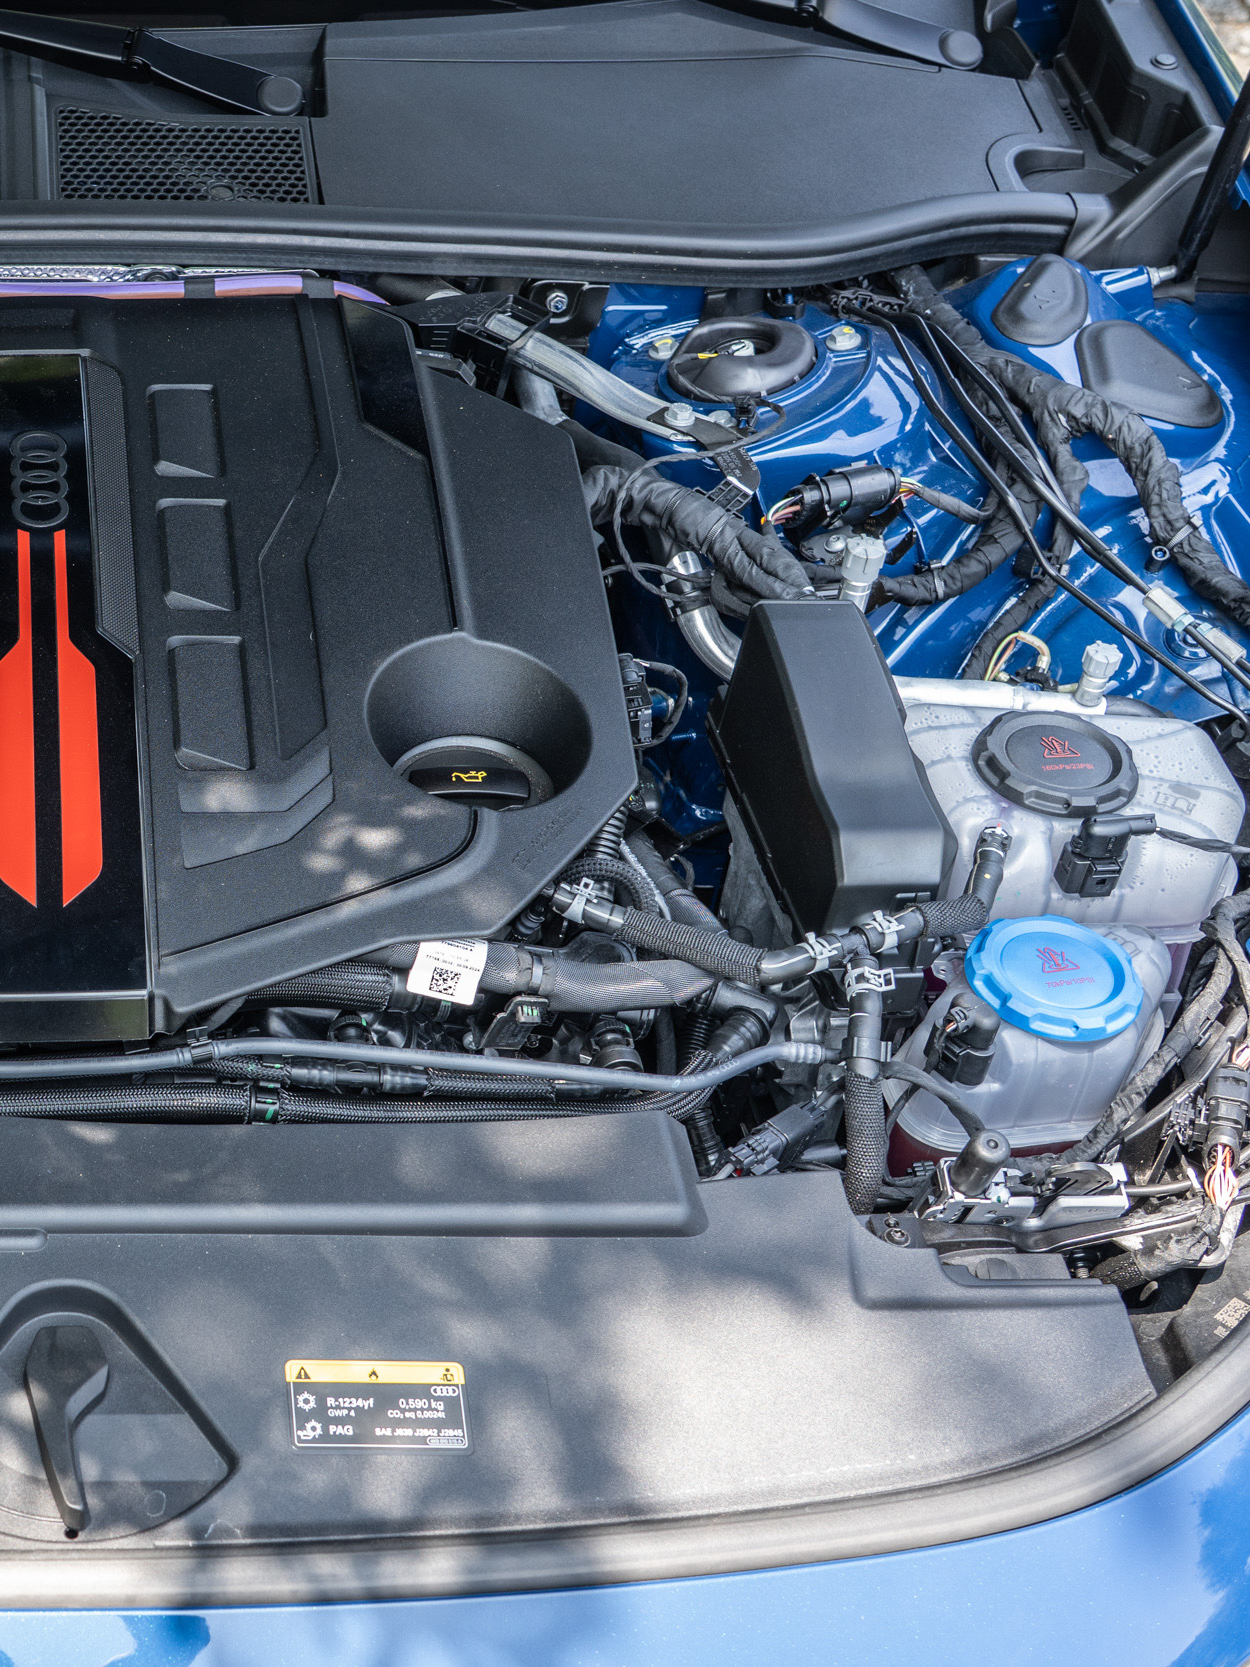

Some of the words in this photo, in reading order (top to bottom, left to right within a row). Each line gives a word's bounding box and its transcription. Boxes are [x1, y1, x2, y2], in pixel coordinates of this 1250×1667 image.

[1045, 977, 1095, 988] 70kPa/10PSI
[327, 1397, 374, 1409] R-1234yf
[399, 1399, 428, 1409] 0,590
[431, 1399, 444, 1410] kg
[328, 1409, 348, 1417] GWP
[349, 1409, 355, 1417] 4
[329, 1425, 353, 1435] PAG
[375, 1428, 392, 1436] SAE
